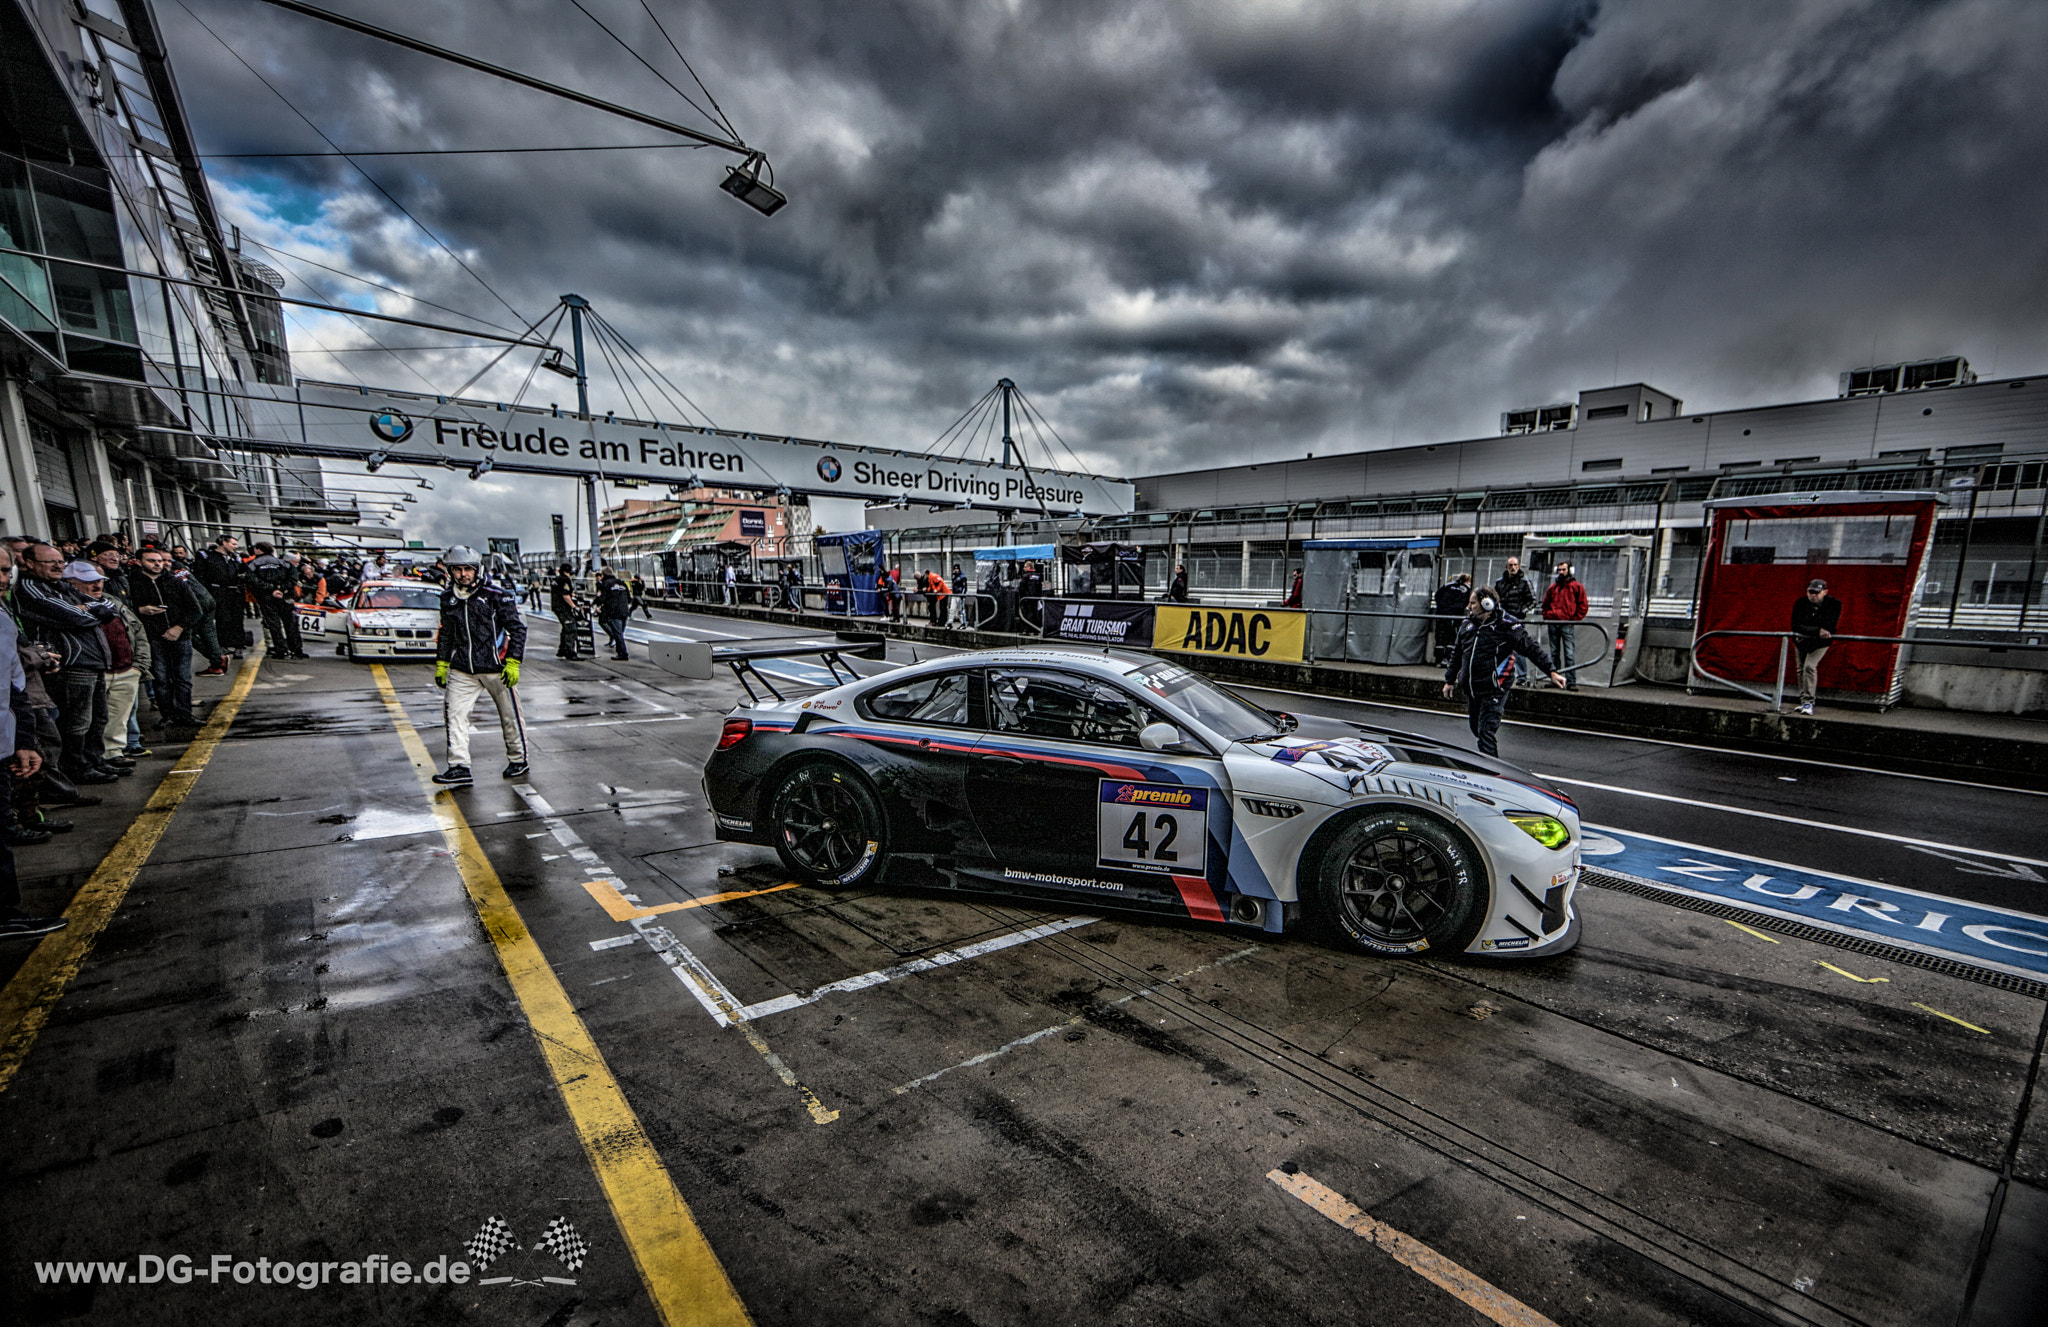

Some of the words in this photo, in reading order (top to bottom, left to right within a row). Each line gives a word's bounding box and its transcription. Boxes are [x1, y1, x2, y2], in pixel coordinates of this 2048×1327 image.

[434, 418, 569, 456] Freude
[579, 440, 630, 462] am
[640, 439, 745, 473] Fahren
[853, 461, 923, 489] Sheer
[928, 469, 999, 500] Driving
[1005, 478, 1084, 504] Pleasure
[301, 616, 320, 632] 64
[1060, 618, 1085, 632] GRAN
[1086, 619, 1127, 636] TURISMO
[1182, 611, 1271, 656] ADAC
[1097, 635, 1124, 643] SIMULATOR
[1429, 772, 1493, 792] UNIWHEELS
[1130, 789, 1192, 804] premio
[720, 817, 751, 827] MICHELIN
[1122, 811, 1178, 862] 42
[842, 857, 870, 882] MICHELIN
[1132, 863, 1170, 872] www.premio.de
[1004, 867, 1124, 891] bmw-motorsport.com
